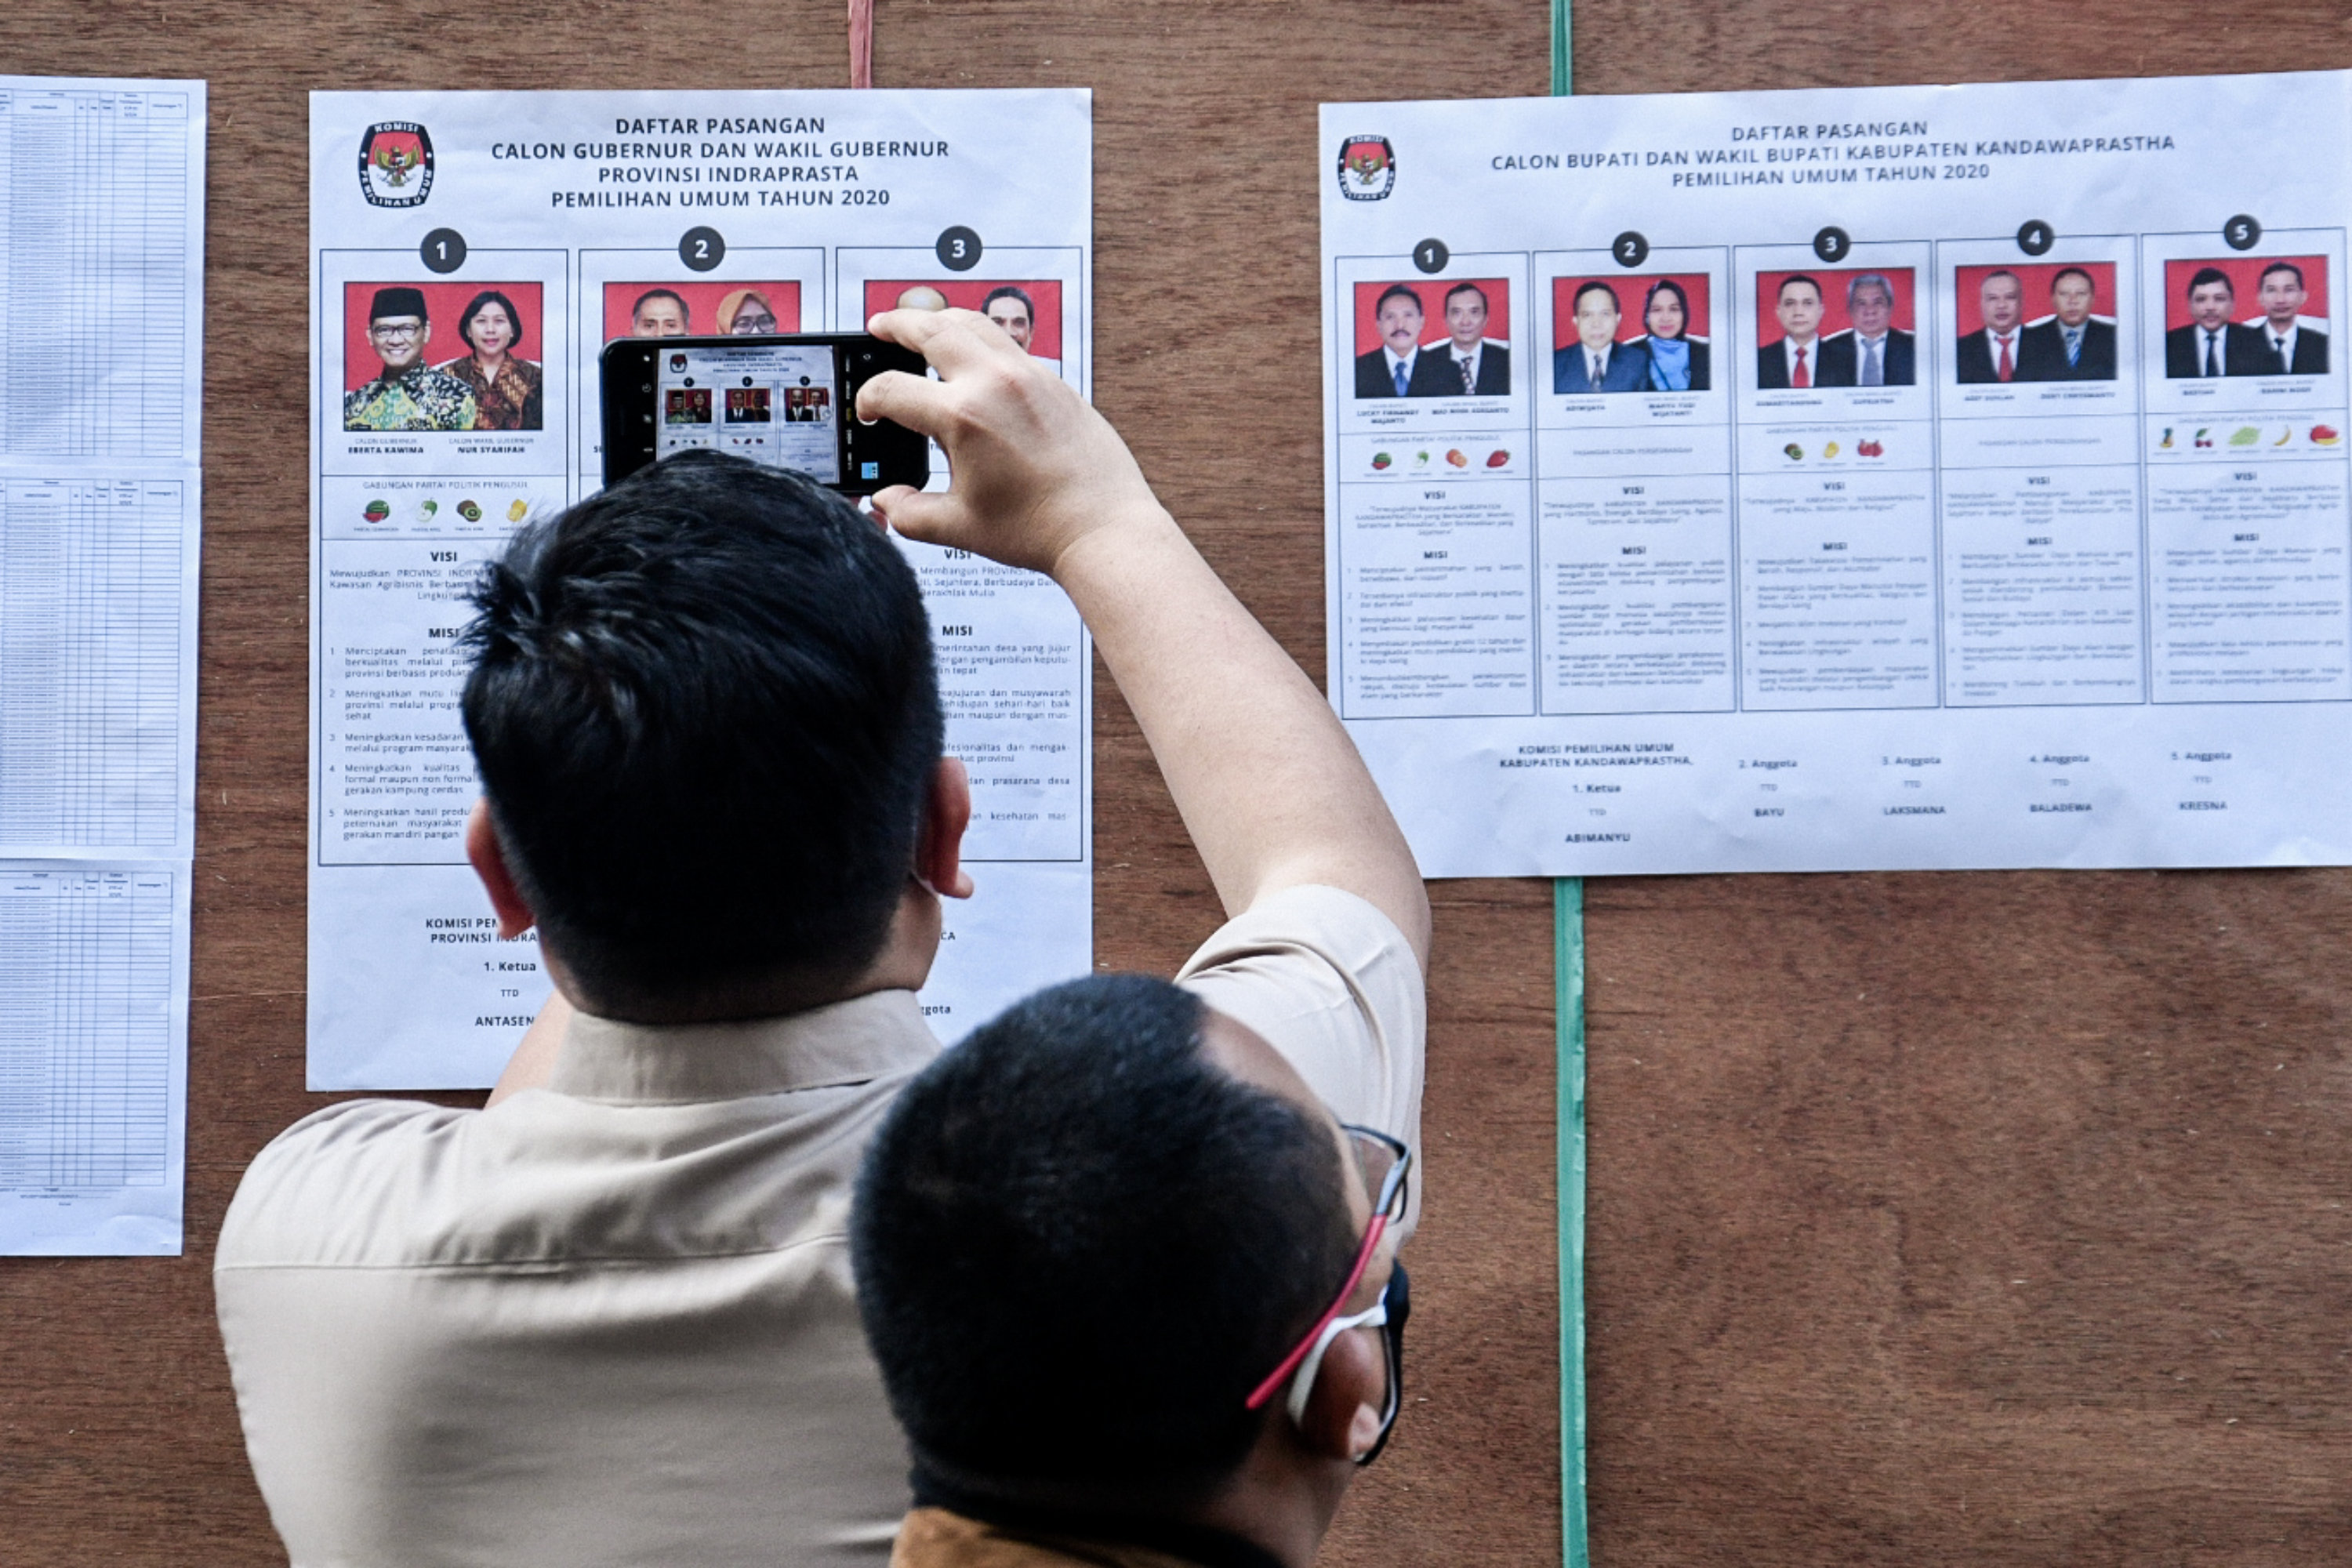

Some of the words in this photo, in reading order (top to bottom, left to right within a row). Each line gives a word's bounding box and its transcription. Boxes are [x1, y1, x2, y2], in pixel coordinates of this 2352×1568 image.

[616, 118, 698, 134] DAFTAR
[707, 118, 824, 133] PASANGAN
[1732, 125, 1809, 142] DAFTAR
[1816, 122, 1927, 139] PASANGAN
[492, 143, 565, 159] CALON
[573, 143, 692, 159] GUBERNUR
[701, 143, 746, 158] DAN
[754, 142, 822, 158] WAKIL
[830, 141, 949, 157] GUBERNUR
[1492, 155, 1559, 170] CALON
[1567, 152, 1638, 168] BUPATI
[1646, 151, 1692, 166] DAN
[1696, 149, 1759, 165] WAKIL
[1767, 147, 1838, 162] BUPATI
[1847, 143, 1967, 159] KABUPATEN
[1976, 136, 2175, 155] KANDAWAPRASTHA
[599, 167, 699, 183] PROVINSI
[710, 166, 858, 182] INDRAPRASTA
[1673, 171, 1783, 187] PEMILIHAN
[1792, 169, 1857, 183] UMUM
[1865, 165, 1936, 181] TAHUN
[1944, 164, 1989, 180] 2020
[552, 191, 670, 208] PEMILIHAN
[681, 191, 749, 206] UMUM
[758, 191, 833, 205] TAHUN
[841, 190, 889, 205] 2020
[2028, 230, 2042, 244] 4
[2234, 225, 2248, 239] 5
[695, 240, 708, 258] 2
[952, 240, 965, 258] 3
[1624, 242, 1636, 256] 2
[1825, 238, 1838, 251] 3
[435, 242, 446, 260] 1
[1424, 248, 1436, 262] 1
[430, 552, 457, 561] VISI
[944, 549, 971, 559] VISI
[920, 566, 978, 577] Membangun
[984, 579, 1035, 587] Berbudaya
[429, 629, 460, 638] MISI
[942, 626, 972, 636] MISI
[346, 648, 406, 656] Menciptakan
[1022, 645, 1044, 655] yang
[1048, 644, 1071, 655] jujur
[345, 670, 383, 679] provinsi
[345, 690, 412, 699] Meningkatkan
[1012, 689, 1071, 698] musyawarah
[345, 702, 383, 710] provinsi
[390, 700, 423, 709] melalui
[1051, 699, 1069, 708] baik
[345, 733, 412, 742] Meningkatkan
[383, 746, 423, 754] program
[1519, 746, 1560, 754] KOMISI
[1565, 744, 1631, 753] PEMILIHAN
[977, 755, 1014, 764] provinsi
[1895, 757, 1941, 767] Anggota
[2042, 755, 2089, 765] Anggota
[2185, 753, 2231, 762] Anggota
[1500, 759, 1570, 768] KABUPATEN
[1752, 760, 1797, 770] Anggota
[345, 764, 411, 774] Meningkatkan
[345, 786, 383, 797] gerakan
[385, 786, 429, 797] kampung
[1884, 806, 1945, 815] LAKSMANA
[2031, 804, 2092, 812] BALADEWA
[2179, 801, 2227, 810] KRESNA
[344, 808, 410, 818] Meningkatkan
[991, 811, 1038, 820] kesehatan
[1755, 808, 1784, 817] BAYU
[408, 818, 461, 829] masyarakat
[343, 831, 382, 841] gerakan
[1566, 834, 1630, 843] ABIMANYU
[426, 919, 471, 928] KOMISI
[431, 933, 491, 943] PROVINSI
[499, 962, 535, 971] Ketua
[475, 1016, 534, 1026] ANTASEN
